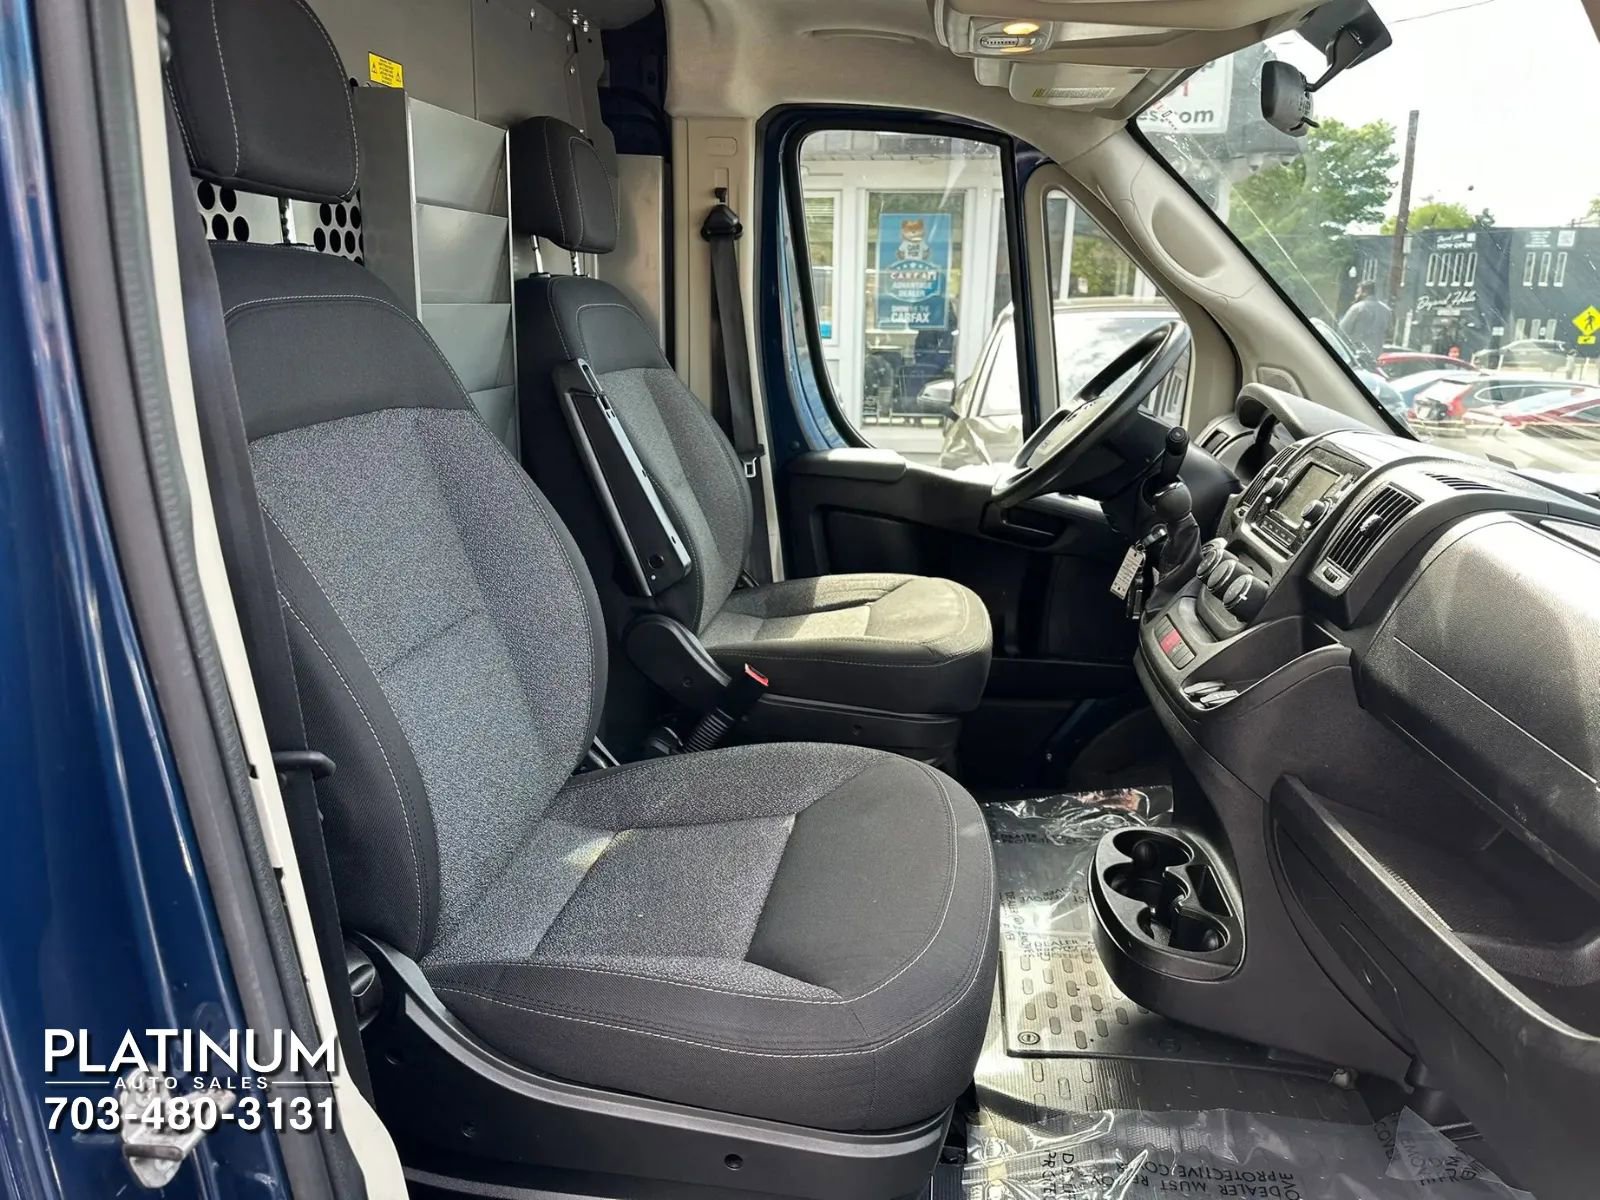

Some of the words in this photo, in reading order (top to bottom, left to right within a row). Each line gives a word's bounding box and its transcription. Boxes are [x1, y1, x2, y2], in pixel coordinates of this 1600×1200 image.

[891, 311, 930, 323] CARFAX
[1115, 1161, 1170, 1176] COR
[1178, 1165, 1277, 1182] PROTECTIVE
[1160, 1180, 1206, 1192] MUST
[1218, 1184, 1281, 1198] DEALER
